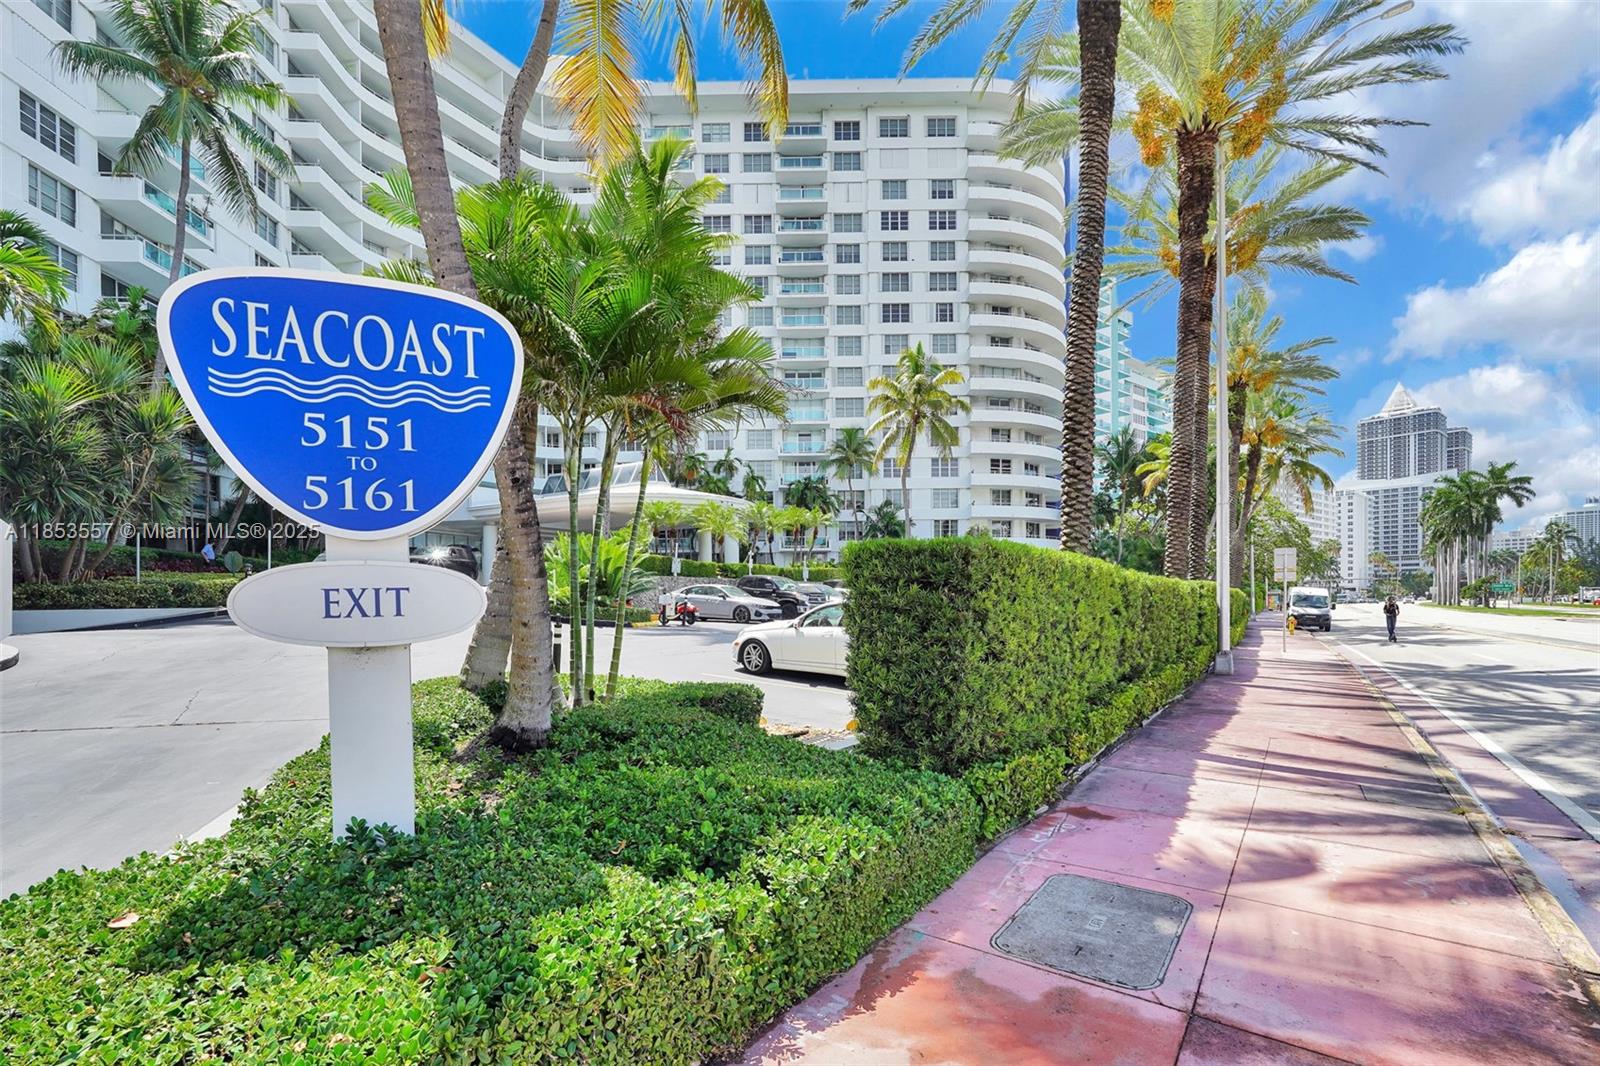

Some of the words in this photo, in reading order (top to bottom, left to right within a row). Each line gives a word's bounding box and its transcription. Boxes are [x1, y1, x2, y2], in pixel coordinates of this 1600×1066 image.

[211, 297, 485, 379] SEACOAST
[301, 412, 416, 452] 5151
[347, 456, 377, 472] TO
[303, 475, 418, 512] 5161
[321, 587, 410, 619] EXIT
